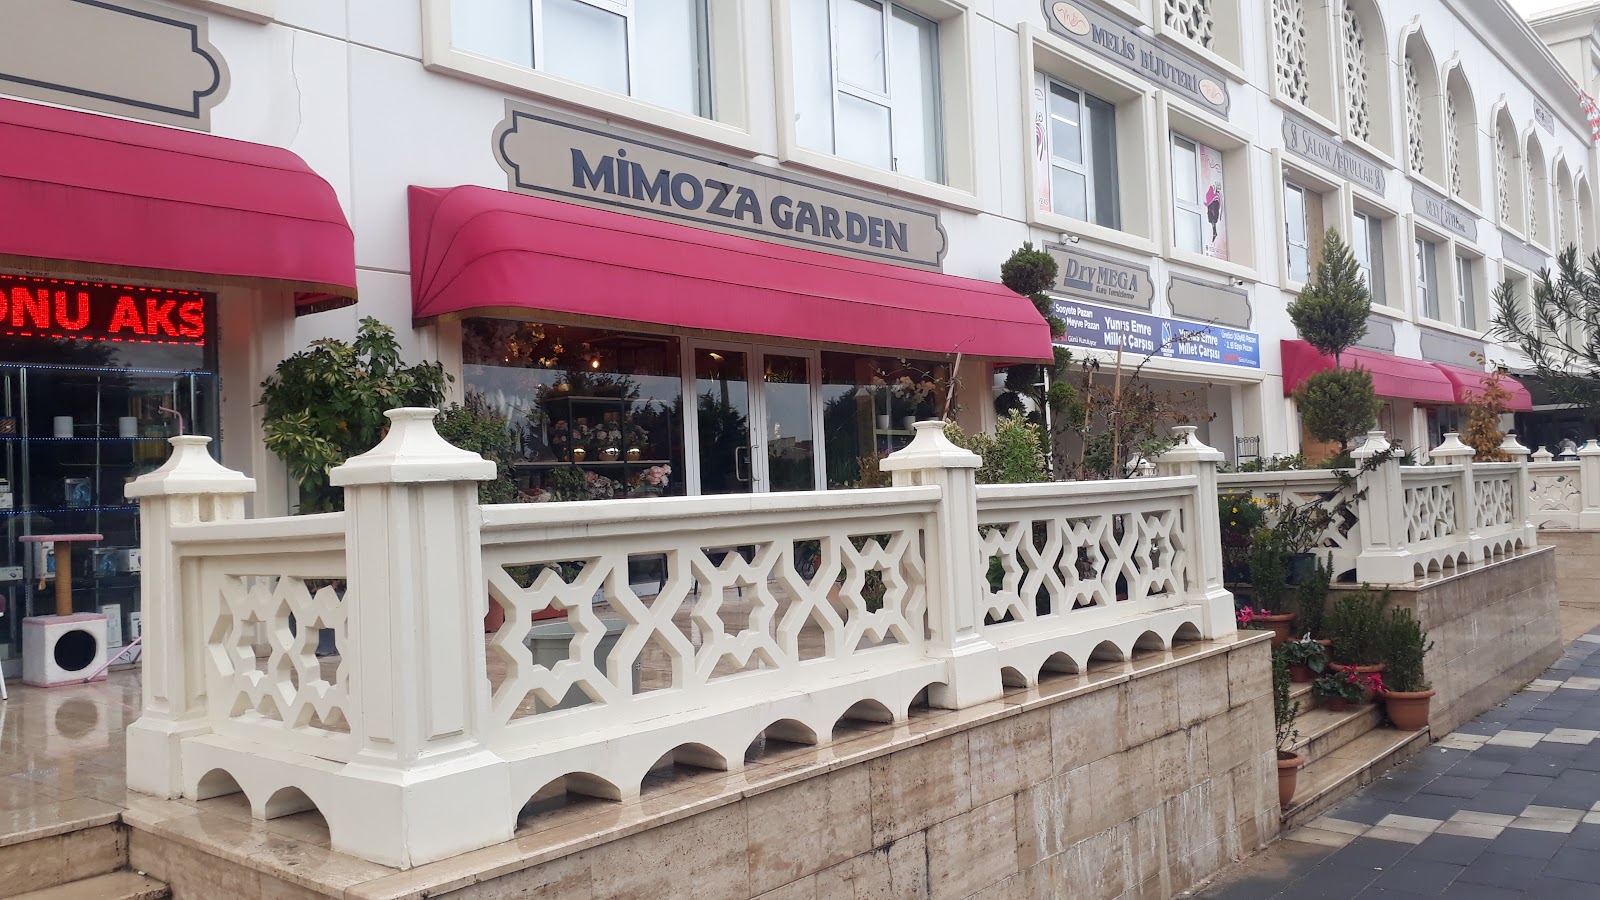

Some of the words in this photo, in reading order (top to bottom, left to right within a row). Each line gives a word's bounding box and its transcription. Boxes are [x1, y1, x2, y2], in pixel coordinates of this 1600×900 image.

[1091, 23, 1135, 62] MELİS
[1140, 50, 1199, 94] BİJUTERİ
[571, 148, 763, 225] MİMOZA
[770, 195, 909, 253] GARDEN
[108, 296, 205, 338] AKS
[1055, 303, 1076, 317] Sosyete
[1104, 316, 1130, 332] Yunus
[1131, 320, 1152, 336] Emre
[1127, 334, 1154, 352] Çarşısı
[1178, 343, 1198, 355] Millet
[1198, 345, 1221, 360] Çarşısı
